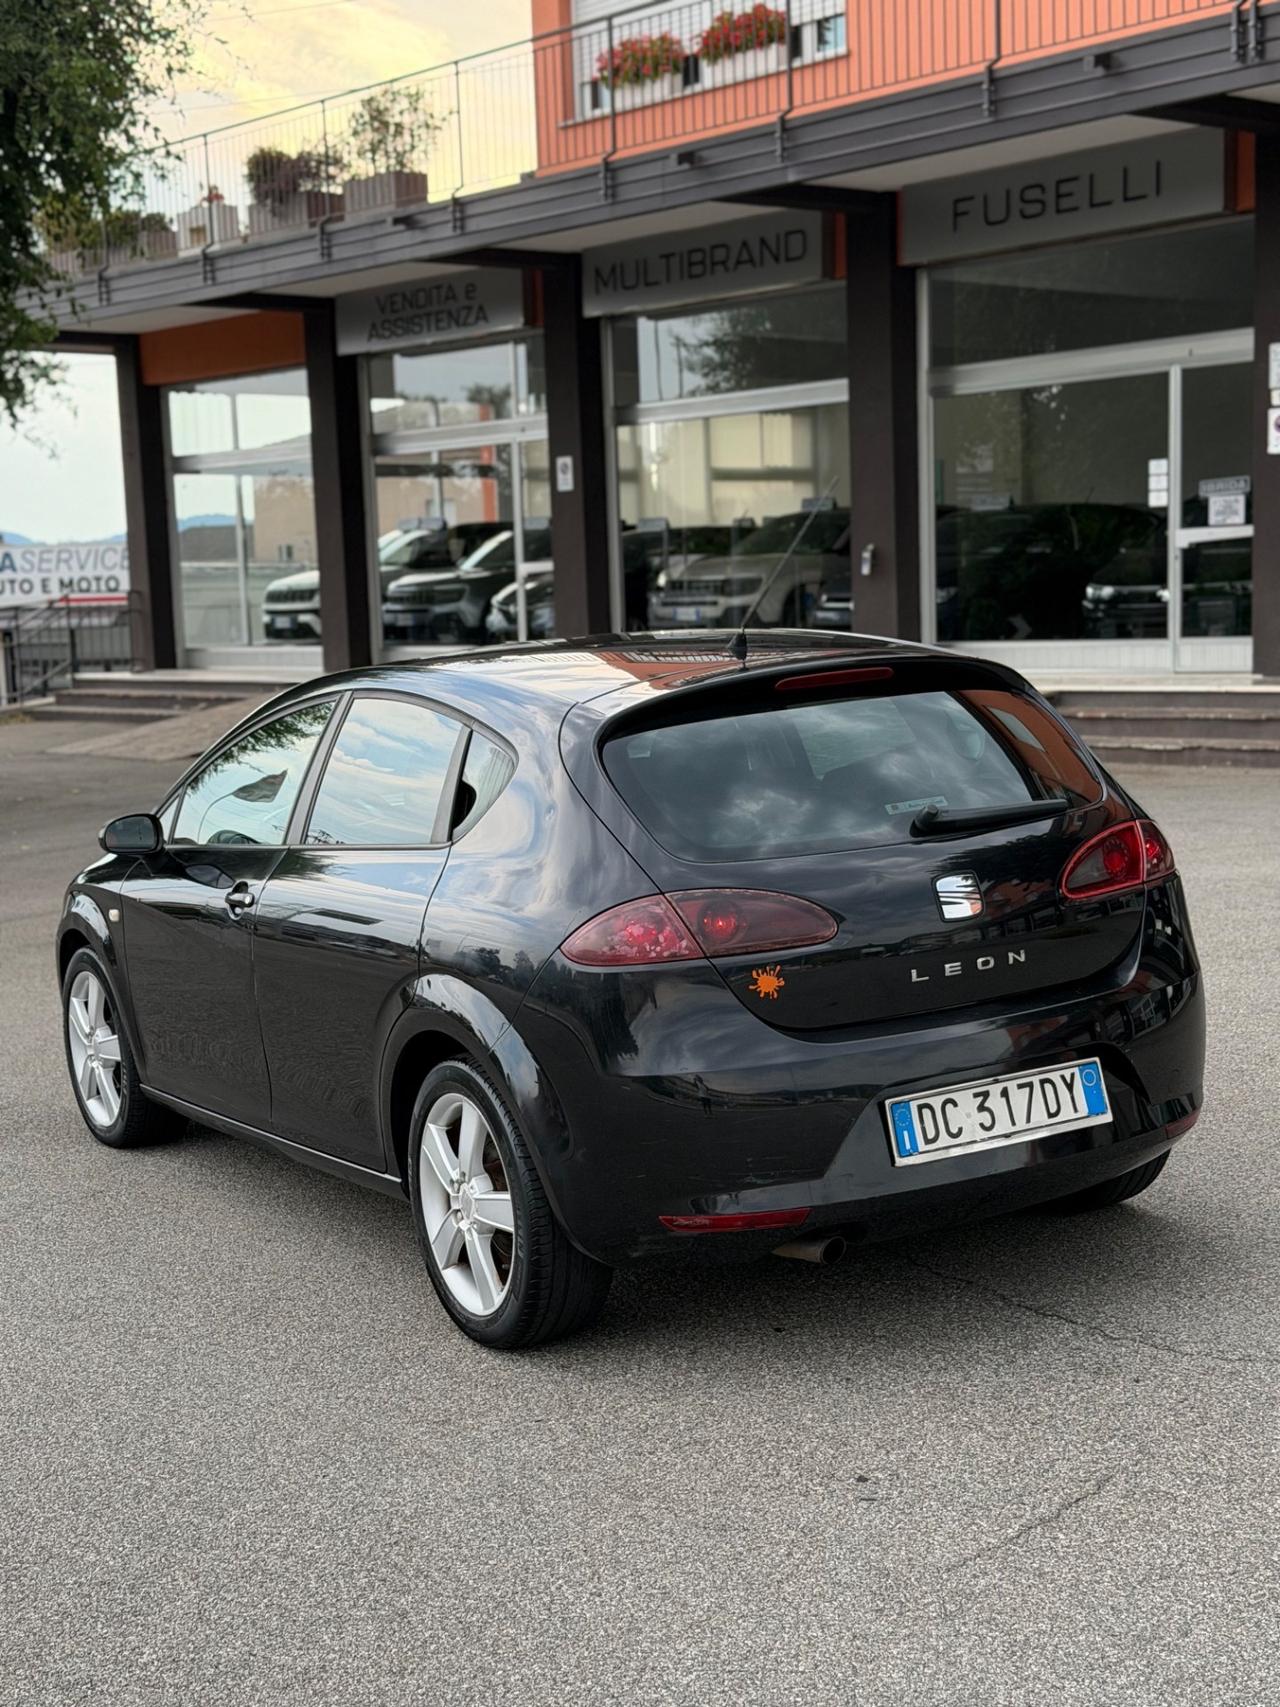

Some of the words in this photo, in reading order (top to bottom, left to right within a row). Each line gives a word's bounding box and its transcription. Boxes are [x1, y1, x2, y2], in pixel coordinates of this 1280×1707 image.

[952, 160, 1161, 233] FUSELLI
[593, 229, 808, 296] MULTIBRAND
[376, 284, 457, 315] VENDITA
[465, 282, 477, 300] e
[367, 304, 489, 343] ASSISTENZA
[41, 576, 51, 594] E
[58, 575, 120, 594] MOTO
[911, 949, 1026, 983] LEON
[916, 1097, 963, 1146] DC
[972, 1072, 1080, 1132] 317DY
